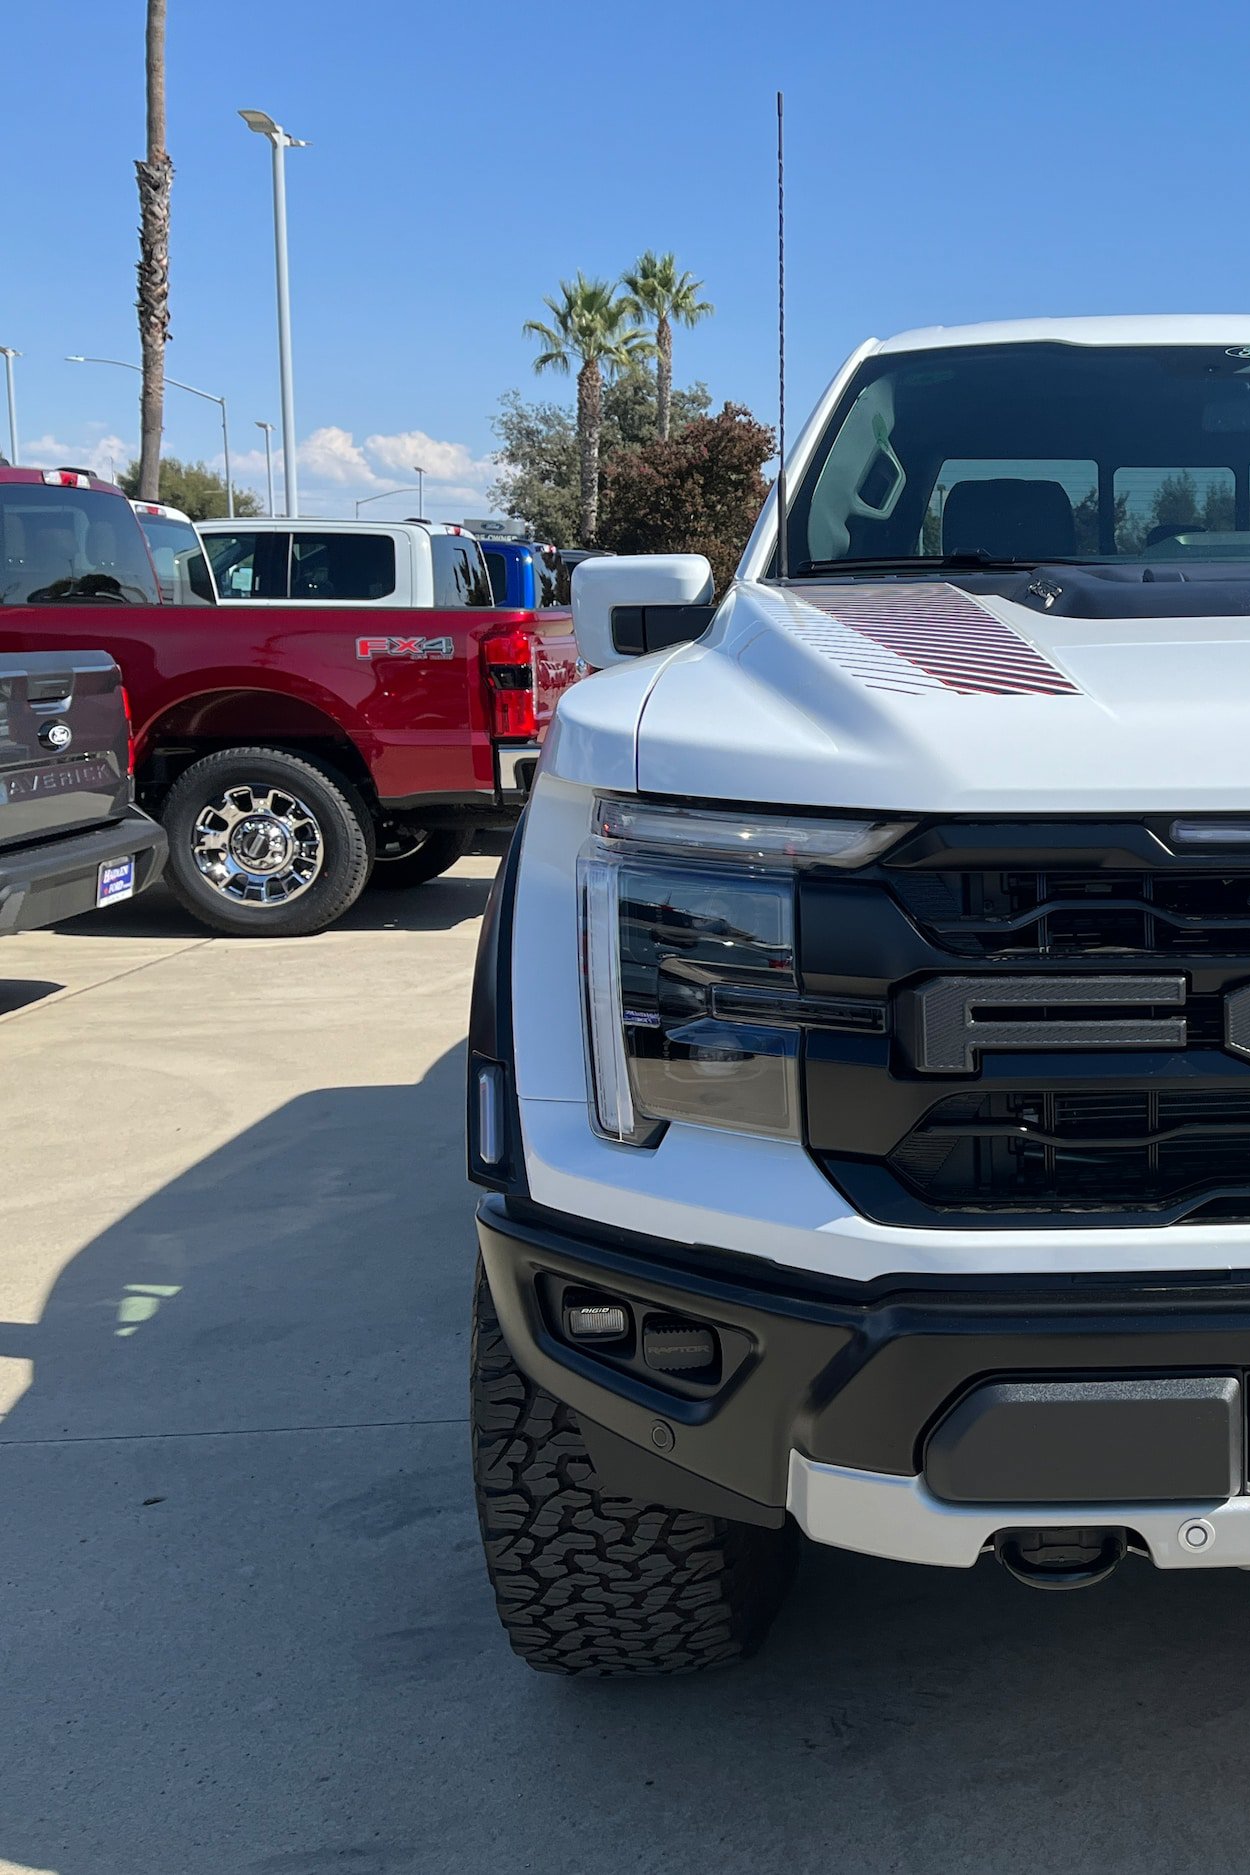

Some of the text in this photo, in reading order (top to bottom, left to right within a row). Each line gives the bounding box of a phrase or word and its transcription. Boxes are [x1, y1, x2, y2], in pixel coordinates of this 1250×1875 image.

[355, 636, 455, 660] FX4
[9, 764, 107, 795] AVERICK
[647, 1344, 710, 1354] RAPTOR
